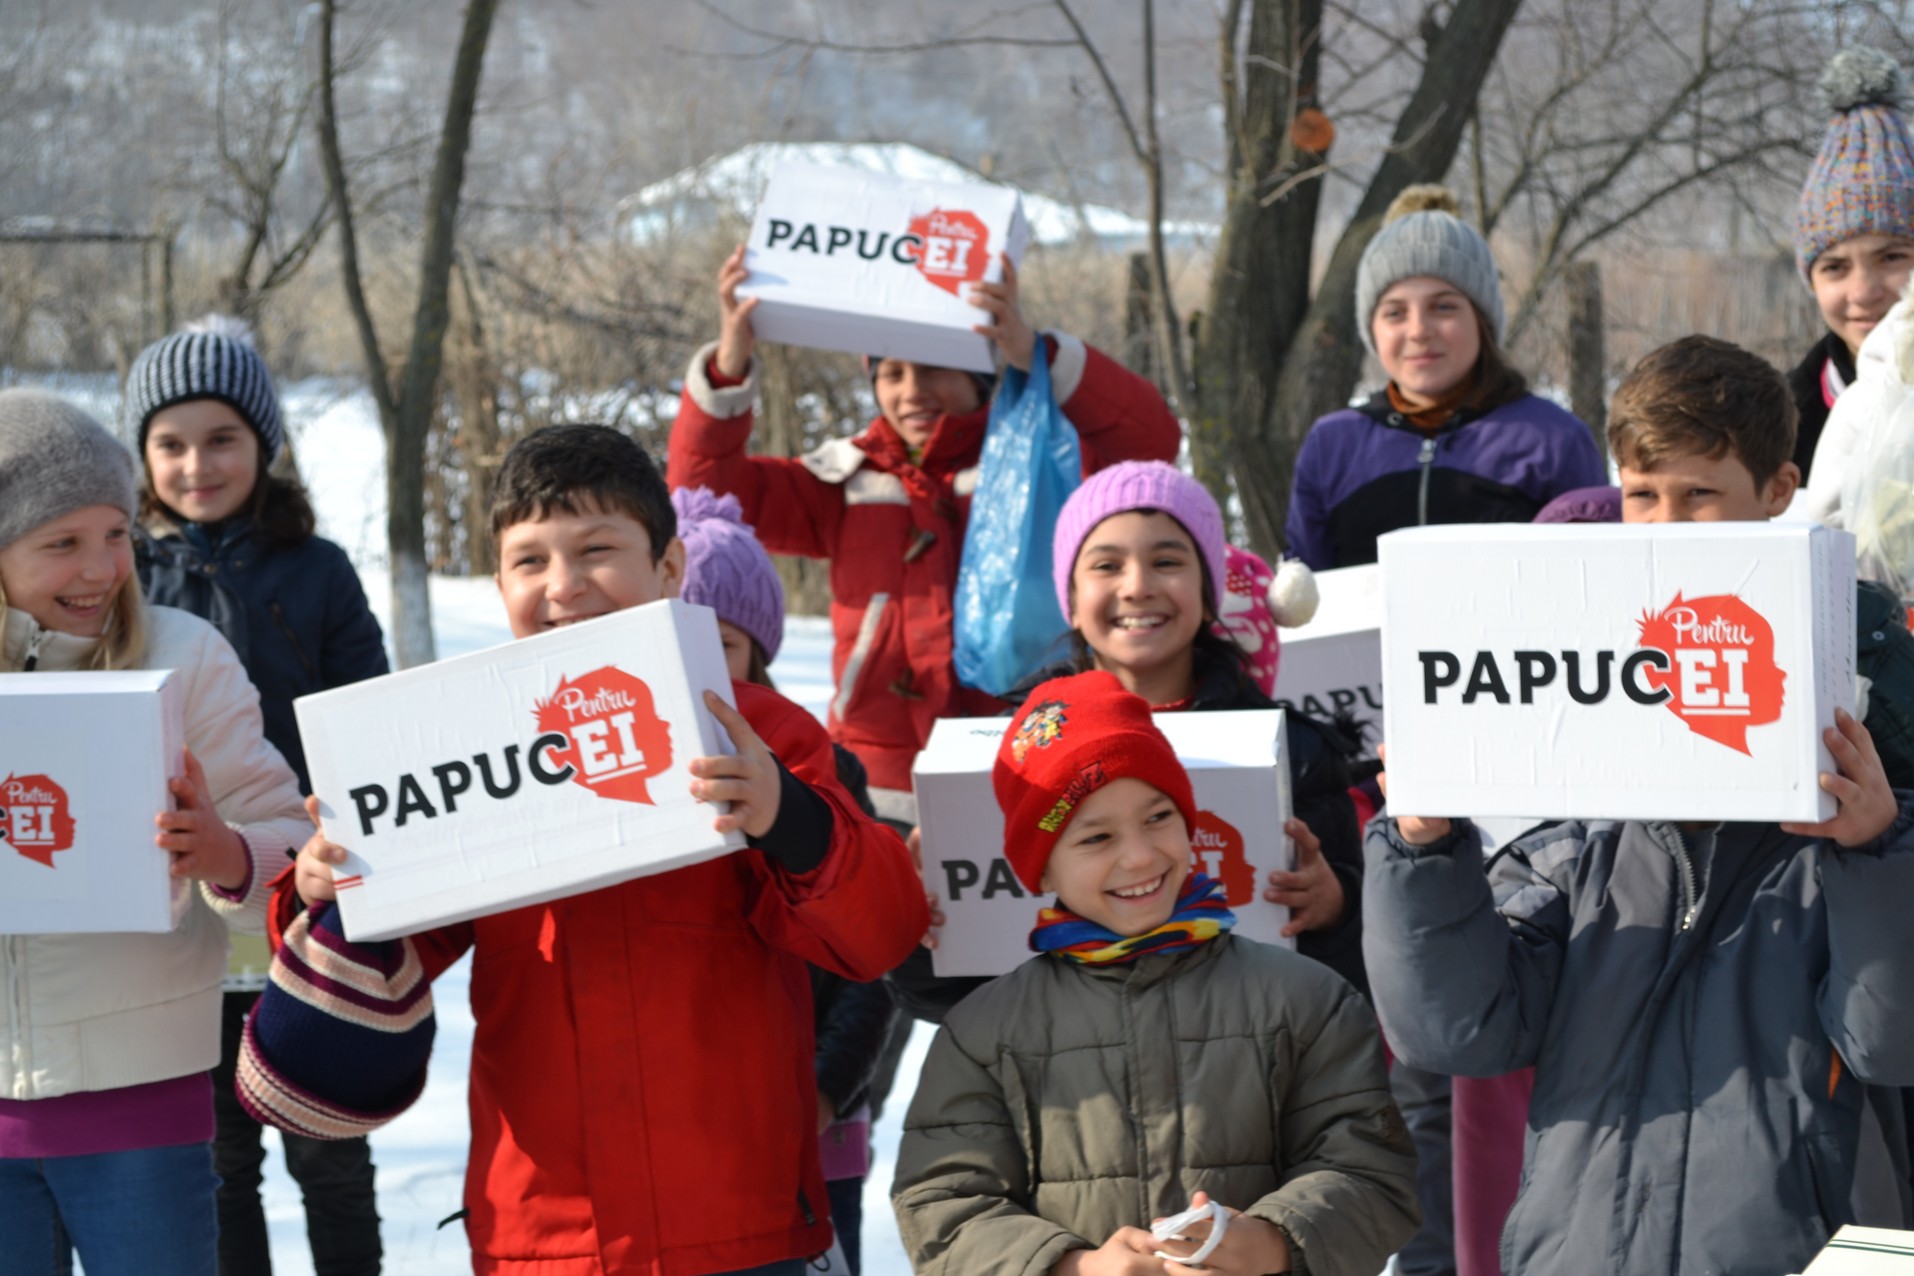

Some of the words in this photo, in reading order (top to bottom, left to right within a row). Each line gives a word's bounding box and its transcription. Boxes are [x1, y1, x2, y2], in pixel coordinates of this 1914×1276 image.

[1664, 606, 1755, 645] Pentru
[553, 687, 636, 722] Pentru
[1277, 683, 1383, 718] APU
[941, 858, 1044, 901] PA
